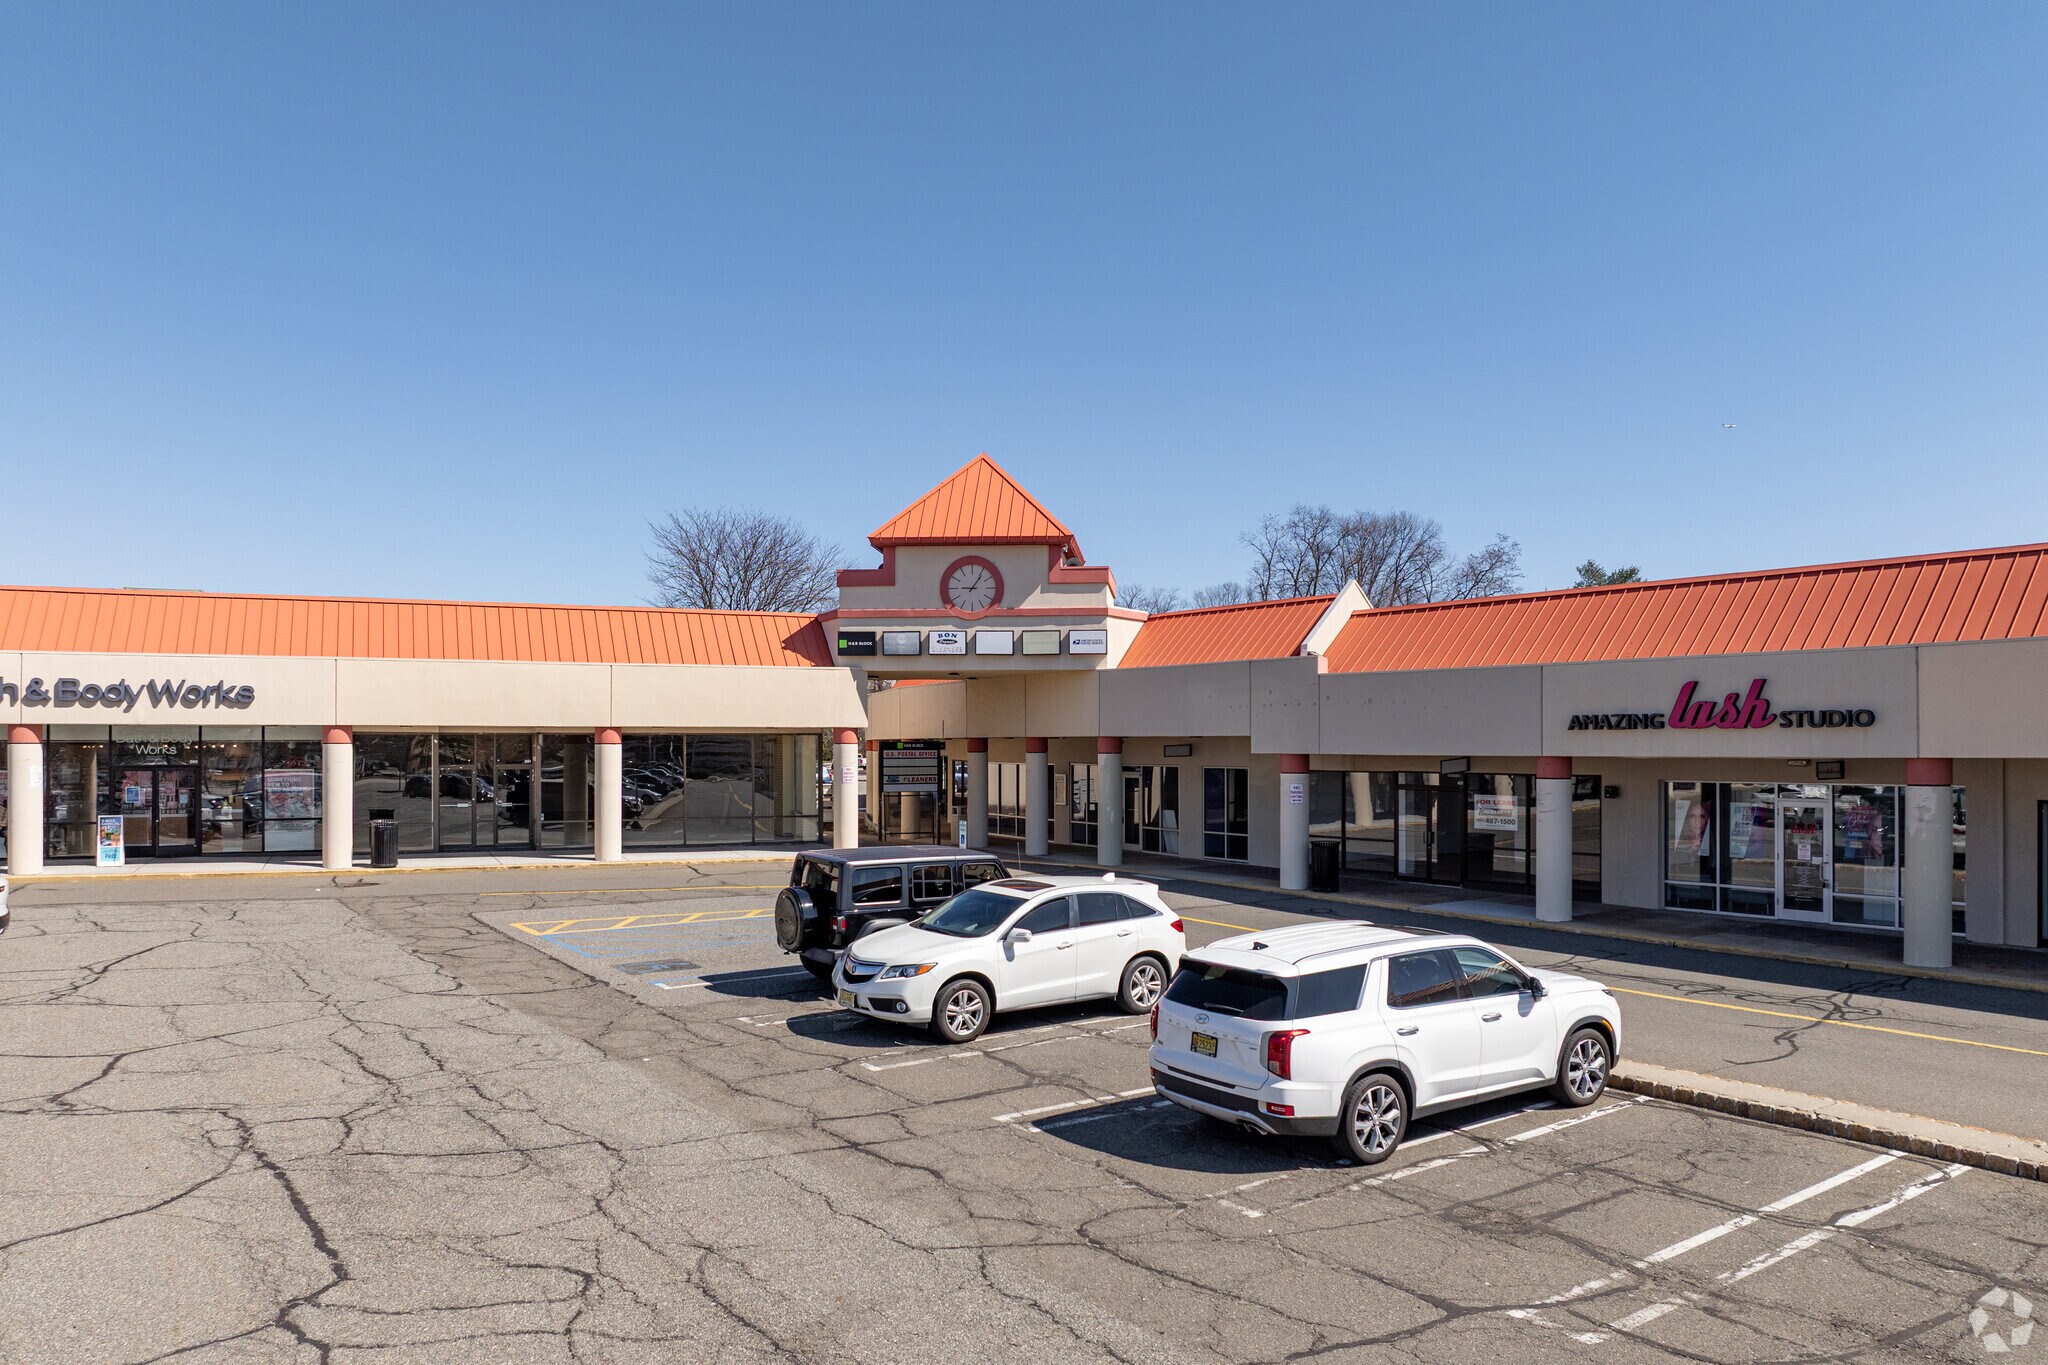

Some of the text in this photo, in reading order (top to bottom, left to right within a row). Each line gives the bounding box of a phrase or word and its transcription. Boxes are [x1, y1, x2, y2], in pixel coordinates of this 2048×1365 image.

[22, 678, 50, 706] &
[54, 678, 146, 711] Body
[147, 679, 255, 708] Works
[1568, 679, 1876, 731] AMAZING lash STUDIO
[135, 745, 177, 754] Works
[1485, 817, 1516, 826] 487-1500
